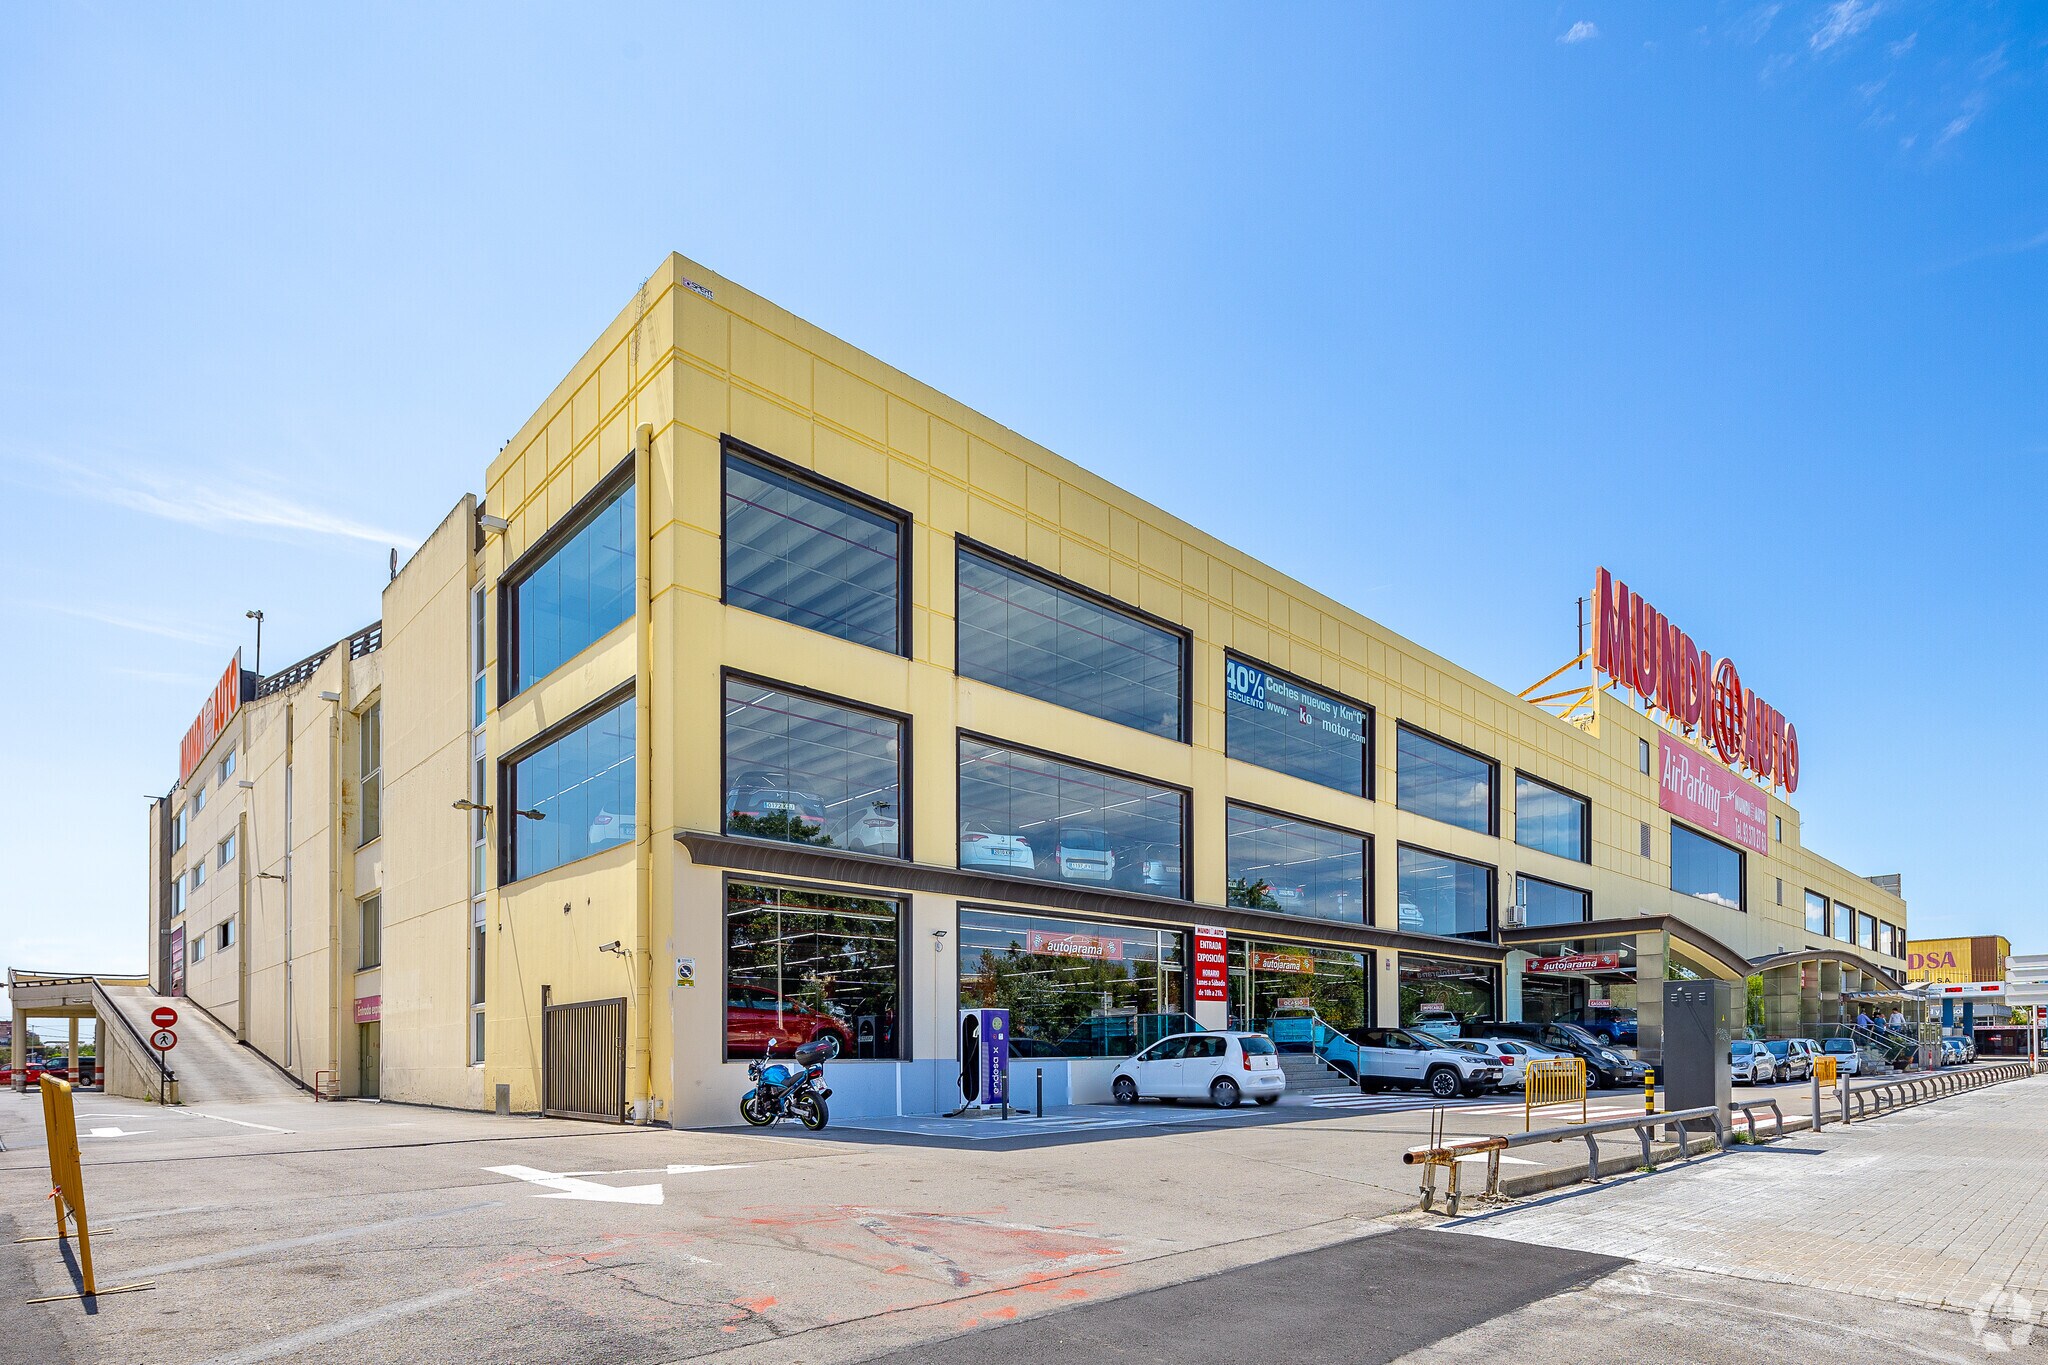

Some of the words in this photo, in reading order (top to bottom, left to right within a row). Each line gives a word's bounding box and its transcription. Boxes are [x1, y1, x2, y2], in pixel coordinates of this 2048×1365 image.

[1227, 689, 1264, 710] ESCUENTO
[1266, 677, 1299, 701] Coches
[1302, 693, 1331, 714] nuevos
[1662, 745, 1721, 827] AirParking
[1047, 941, 1103, 955] autojarama
[1200, 940, 1222, 949] ENTRADA
[1262, 959, 1300, 970] autojarama
[1543, 959, 1598, 971] autojarama
[1196, 978, 1208, 986] Lunes
